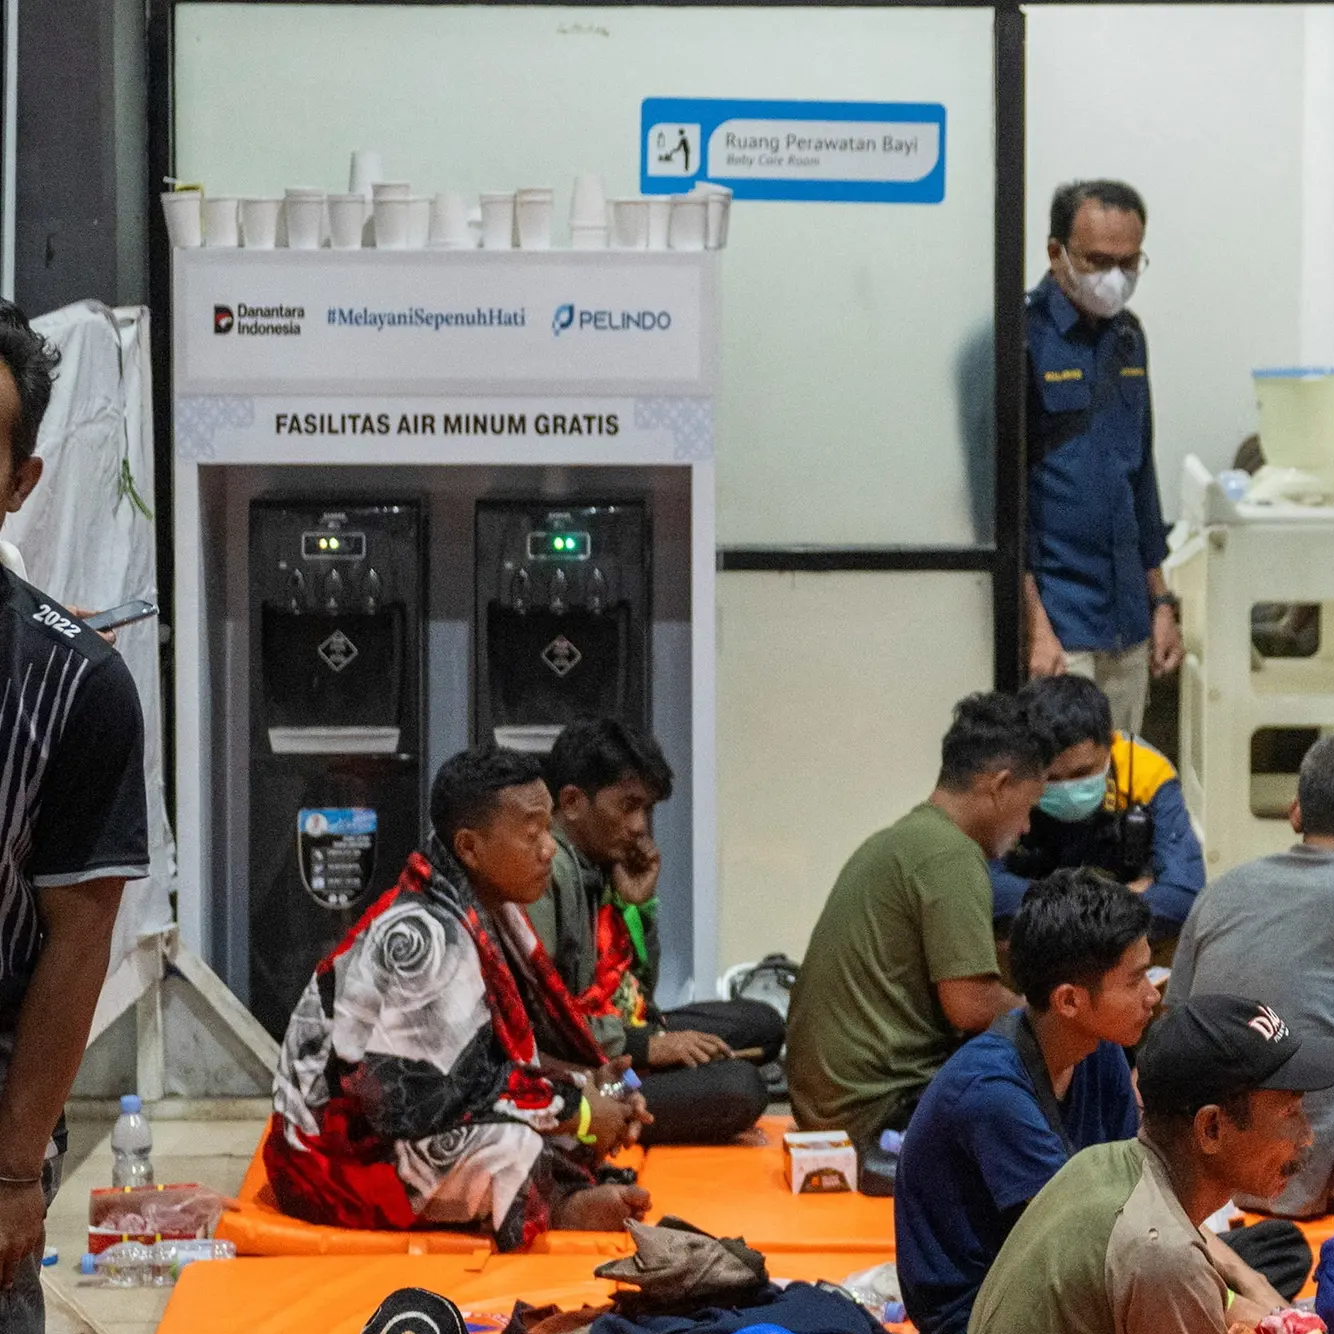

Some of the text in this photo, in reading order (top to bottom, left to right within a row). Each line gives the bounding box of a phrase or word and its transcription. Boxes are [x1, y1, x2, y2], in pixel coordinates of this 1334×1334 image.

[725, 132, 918, 156] Ruang Perawatan Bayi
[726, 153, 820, 168] Baby Care Room
[237, 303, 305, 319] Danantara
[327, 307, 526, 331] #MelayaniSepenuhHati
[579, 310, 672, 331] PELINDO
[237, 320, 301, 336] Indonesia
[275, 413, 620, 437] FASILITAS AIR MINUM GRATIS
[32, 604, 82, 638] 2022
